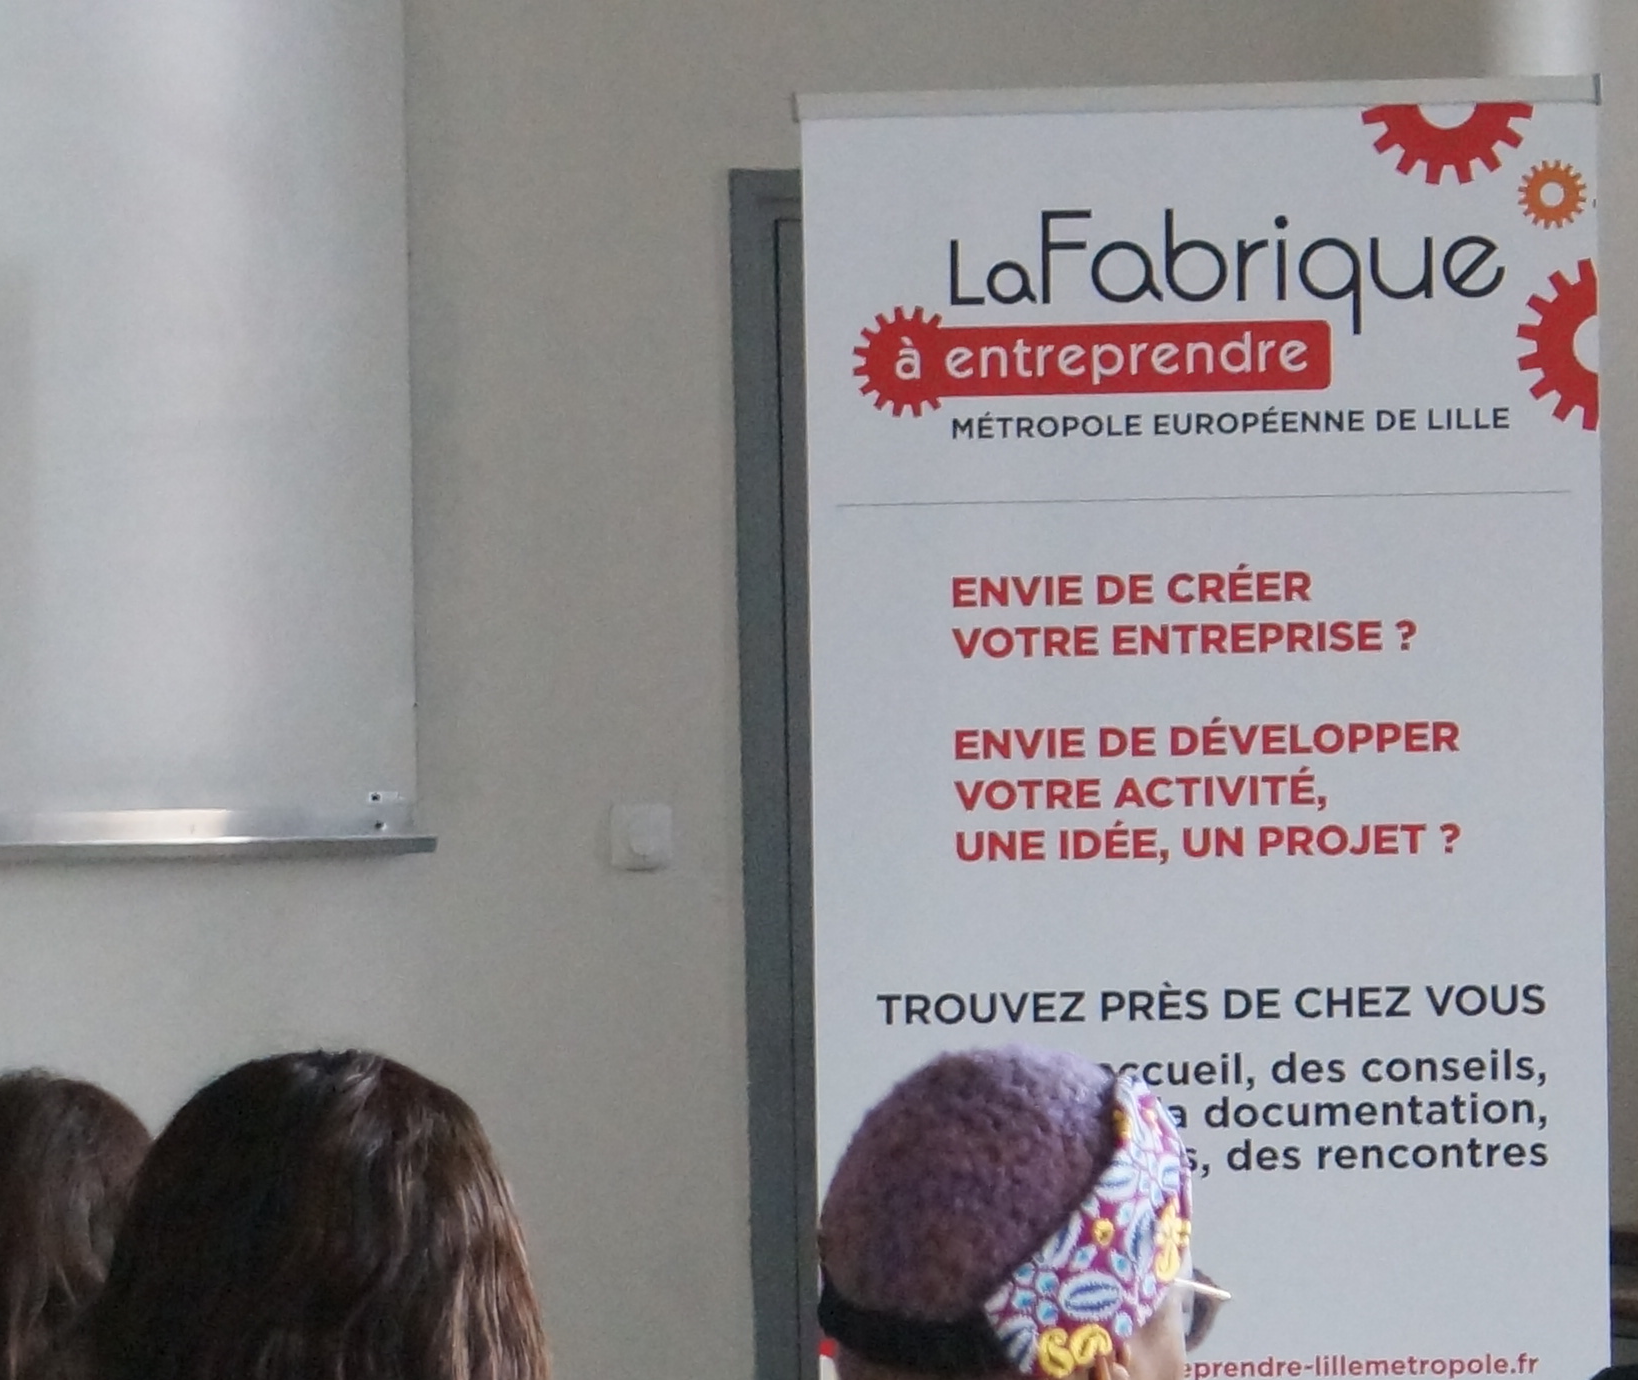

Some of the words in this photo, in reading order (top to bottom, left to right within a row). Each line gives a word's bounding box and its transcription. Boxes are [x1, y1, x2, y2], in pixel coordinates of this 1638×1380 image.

[894, 336, 922, 380] à
[944, 331, 1309, 385] entreprendre
[951, 411, 1143, 440] MÉTROPOLE
[1153, 406, 1365, 435] EUROPÉENNE
[1375, 408, 1417, 433] DE
[1427, 406, 1510, 431] LILLE
[951, 574, 1084, 608] ENVIE
[1096, 574, 1155, 606] DE
[1166, 563, 1312, 604] CRÉER
[951, 624, 1100, 659] VOTRE
[1112, 620, 1383, 656] ENTREPRISE
[1395, 619, 1417, 652] ?
[954, 726, 1086, 760] ENVIE
[1098, 726, 1157, 759] DE
[1169, 716, 1460, 757] DÉVELOPPER
[953, 778, 1102, 811] VOTRE
[1113, 765, 1329, 811] ACTIVITÉ,
[955, 829, 1046, 862] UNE
[1059, 819, 1170, 866] IDÉE,
[1182, 825, 1244, 859] UN
[1258, 823, 1428, 857] PROJET
[1439, 822, 1461, 855] ?
[876, 990, 1086, 1025] TROUVEZ
[1100, 980, 1209, 1023] PRÈS
[1223, 987, 1282, 1021] DE
[1294, 985, 1412, 1020] CHEZ
[1424, 983, 1546, 1017] VOUS
[1270, 1050, 1347, 1085] des
[1361, 1047, 1547, 1088] conseils,
[1203, 1093, 1548, 1130] documentation,
[1226, 1138, 1302, 1172] des
[1317, 1138, 1549, 1171] rencontres
